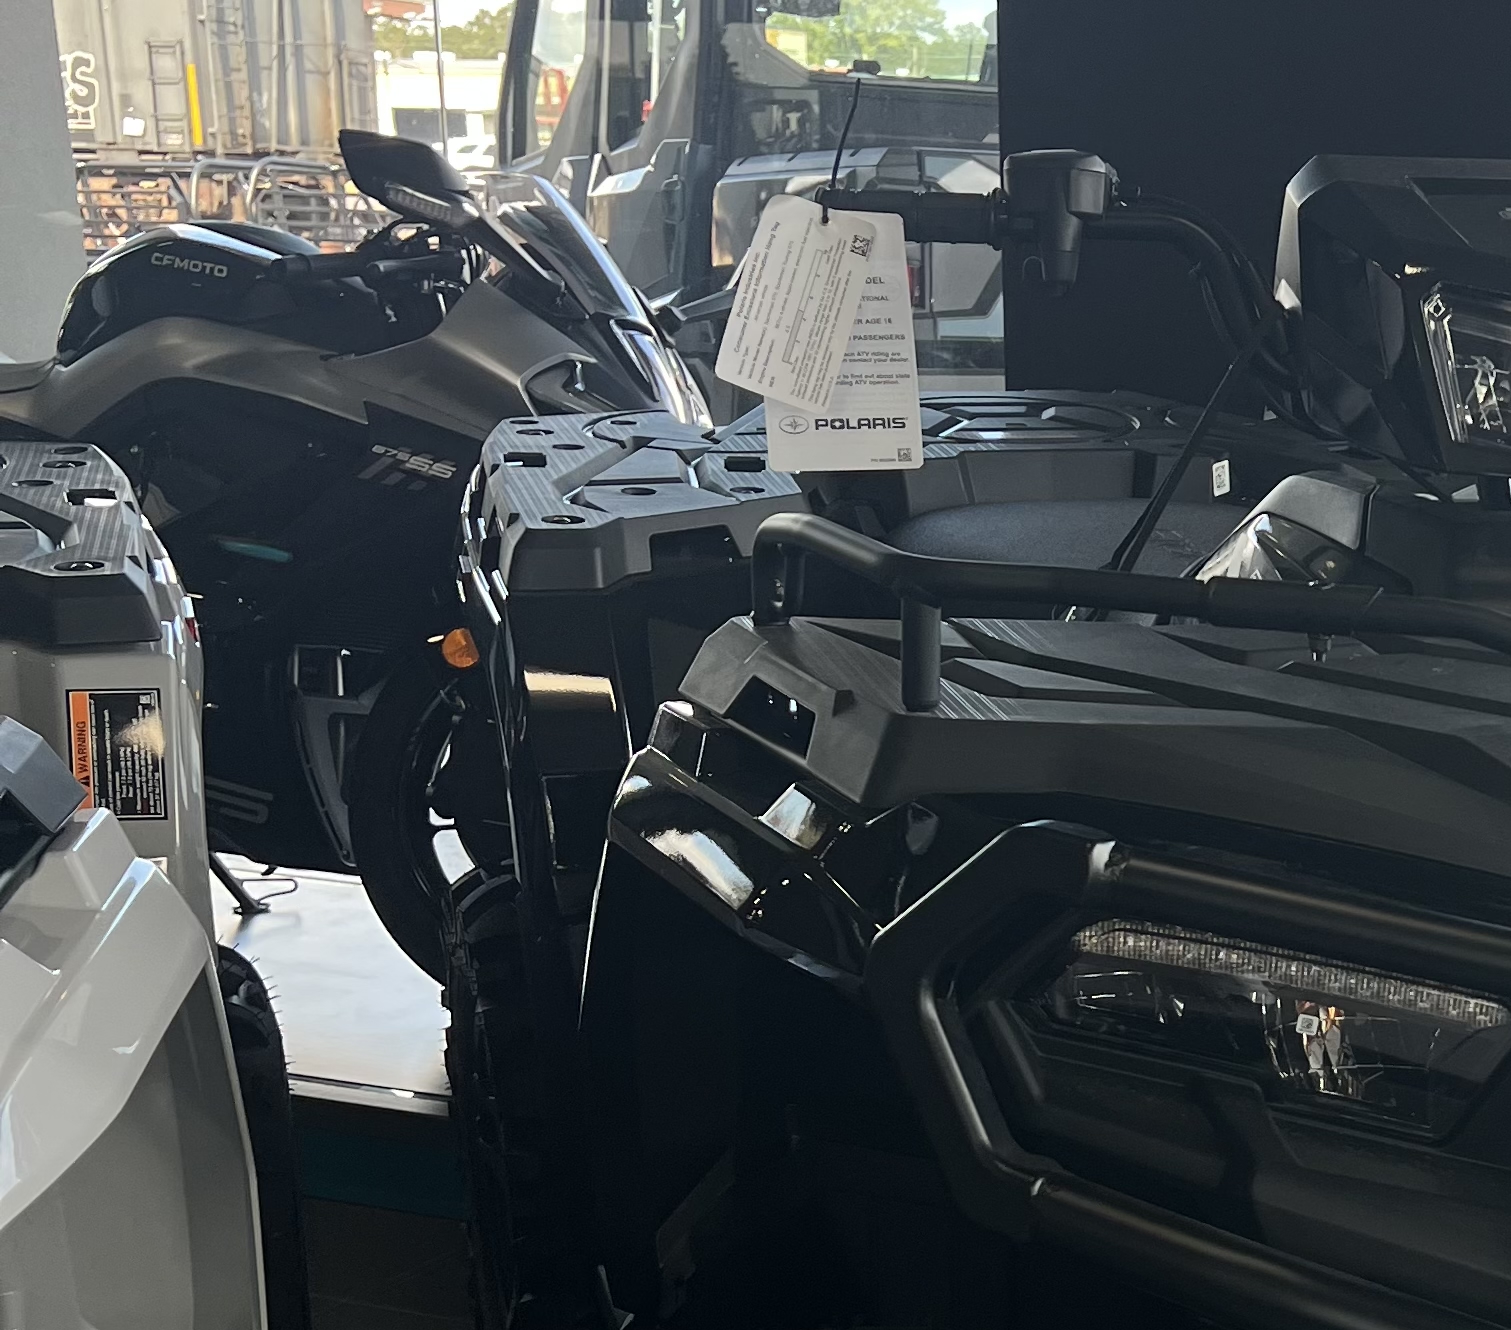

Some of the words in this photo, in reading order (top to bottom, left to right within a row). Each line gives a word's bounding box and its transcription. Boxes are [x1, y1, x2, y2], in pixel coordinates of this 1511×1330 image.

[151, 252, 228, 278] CFMOTO
[814, 418, 906, 430] POLARIS
[76, 721, 88, 773] WARNING
